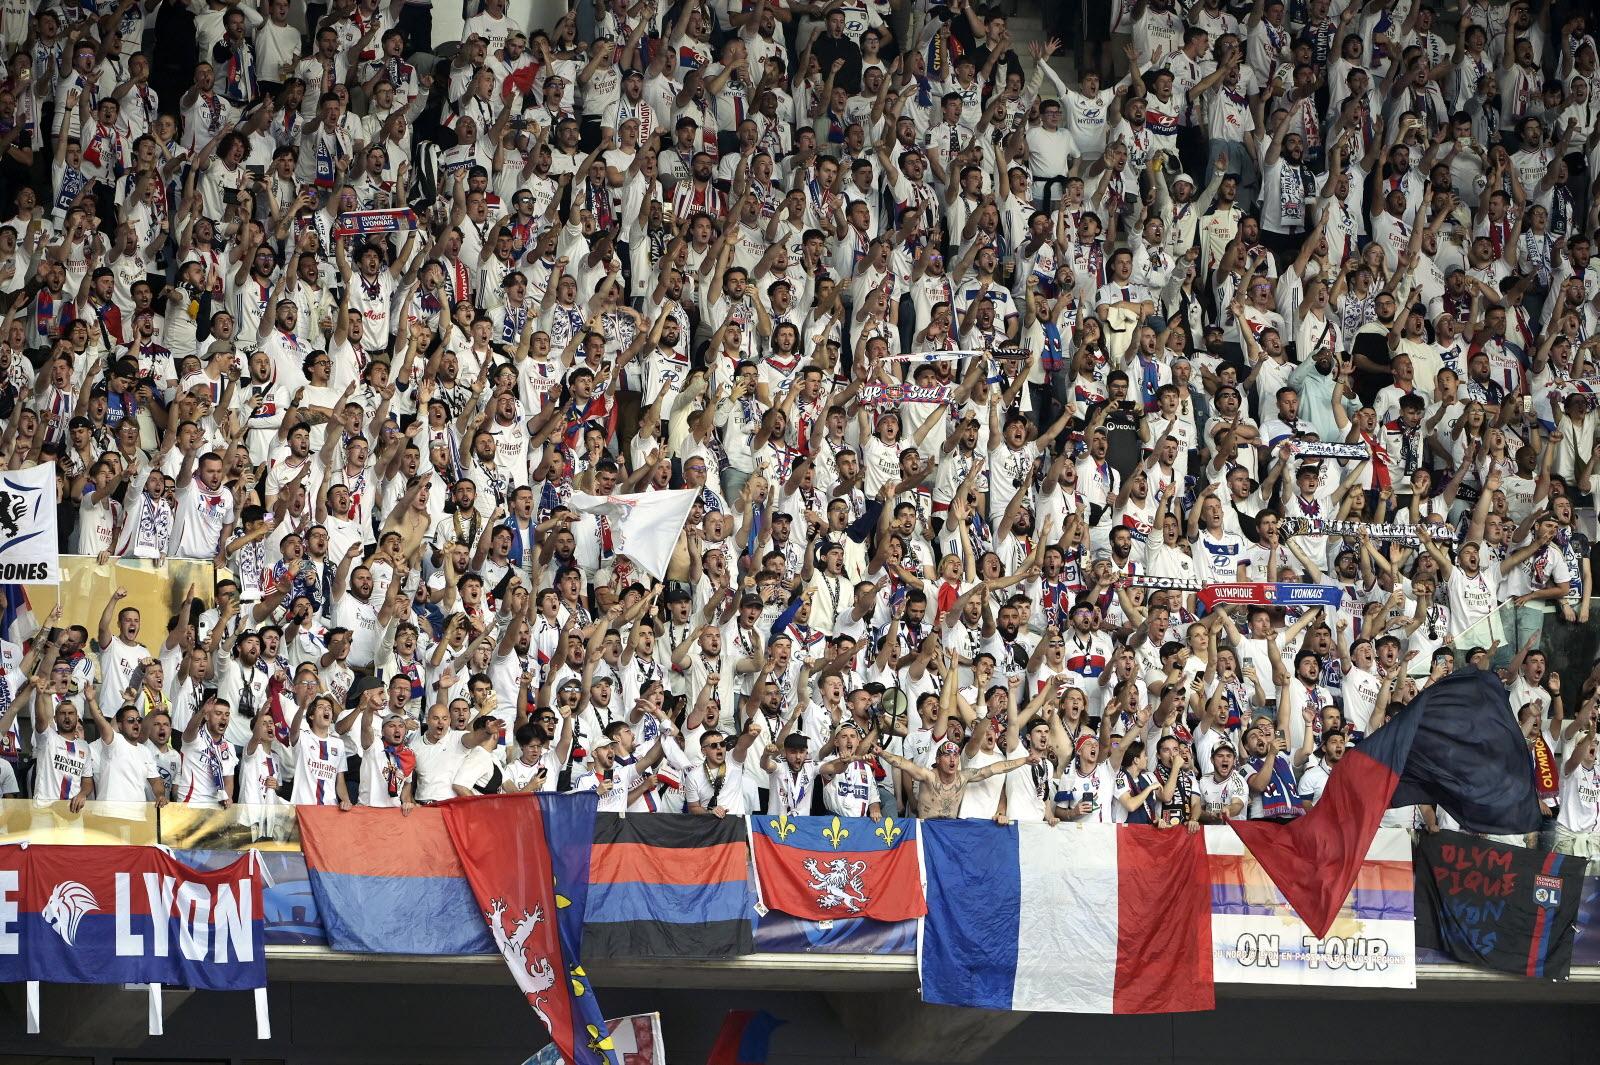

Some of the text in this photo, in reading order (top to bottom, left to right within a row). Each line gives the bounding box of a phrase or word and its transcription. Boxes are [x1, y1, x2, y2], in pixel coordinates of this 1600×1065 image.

[361, 214, 394, 222] OLYMPIQUE
[362, 219, 394, 228] LYONNAIS
[908, 385, 940, 400] Sud
[1215, 587, 1253, 599] OLYMPIQUE
[1290, 588, 1324, 599] LYONNAIS
[1464, 590, 1491, 600] Emirates
[307, 759, 337, 774] Emirates
[1441, 844, 1513, 871] OLYM
[115, 871, 253, 963] LYON
[1236, 932, 1389, 971] ON TOUR
